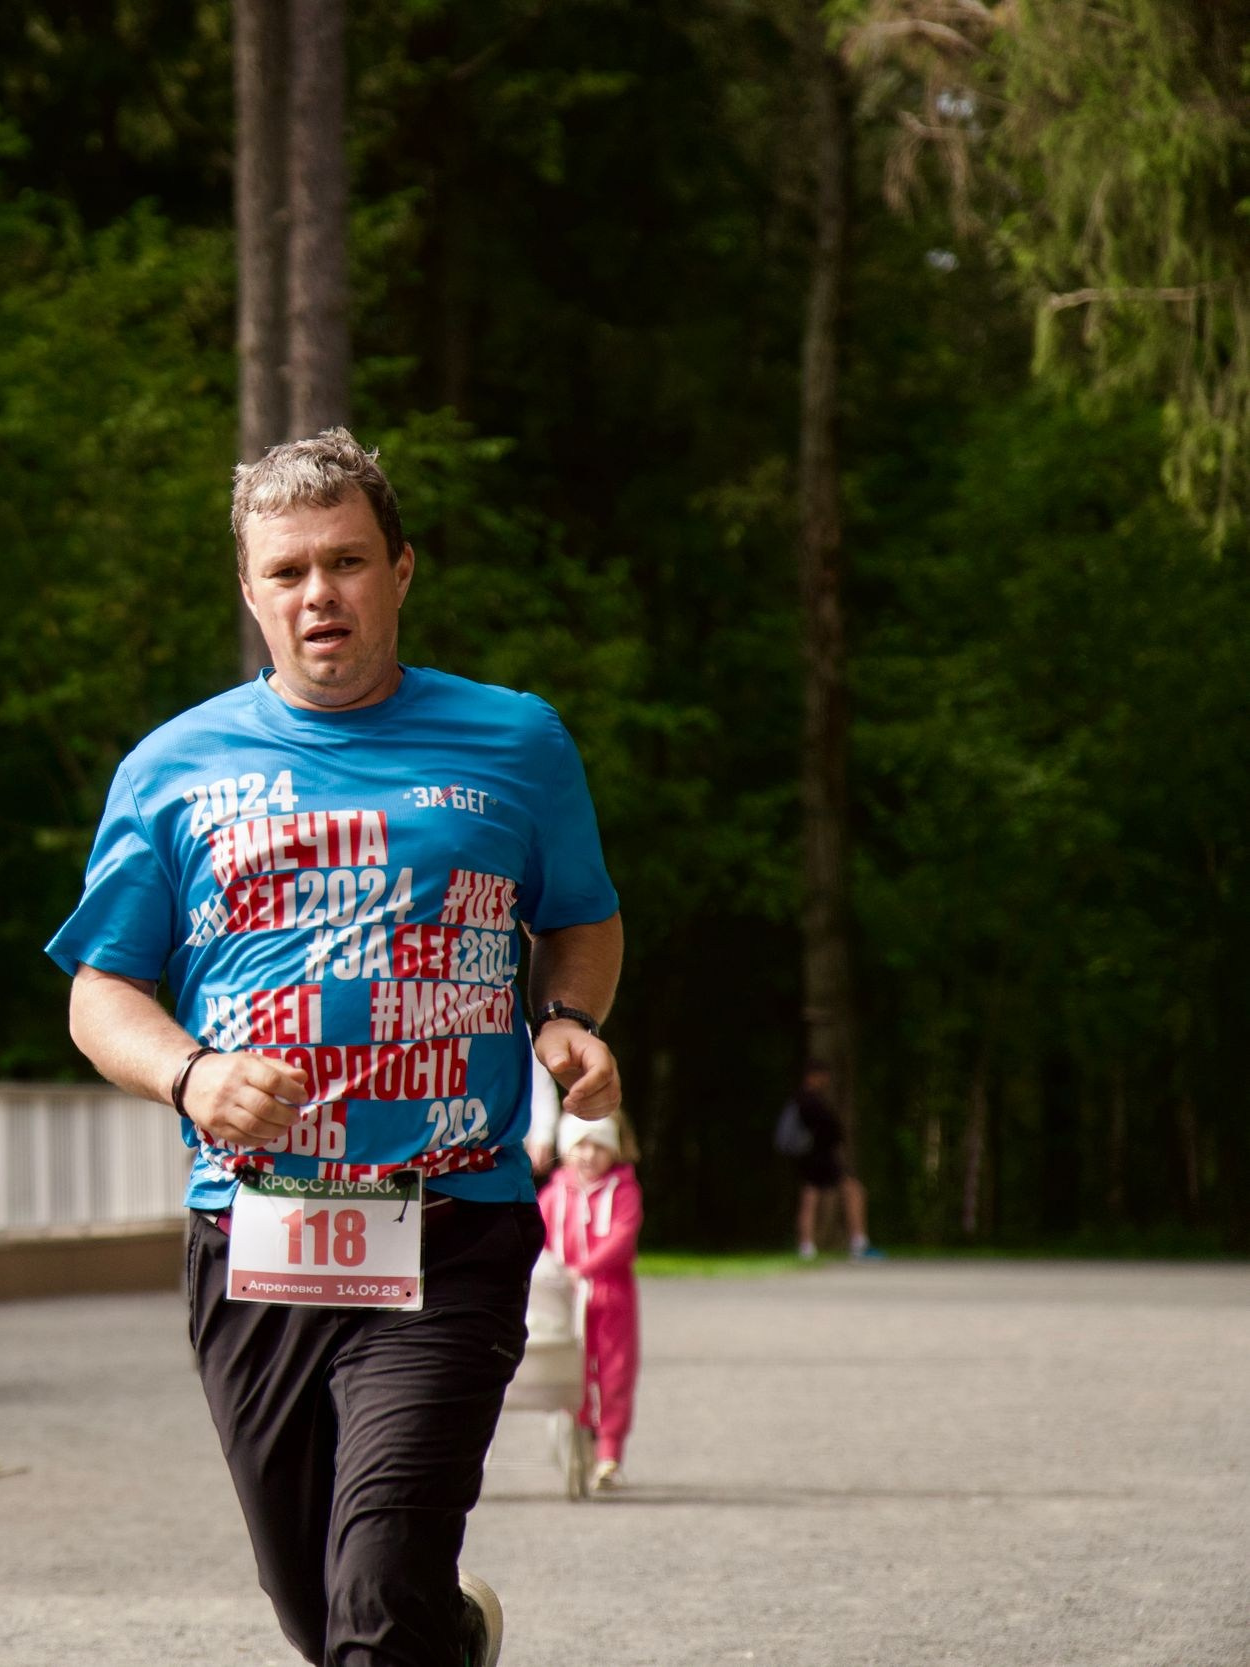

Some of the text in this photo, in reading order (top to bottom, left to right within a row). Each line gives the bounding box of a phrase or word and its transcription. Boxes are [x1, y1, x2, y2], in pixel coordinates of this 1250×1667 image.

[182, 769, 299, 838] 2024
[208, 810, 388, 887] #МЕЧТА
[258, 1174, 325, 1192] КРОСС
[281, 1208, 367, 1267] 118
[248, 1279, 400, 1297] Апрелевка 14.09.25
